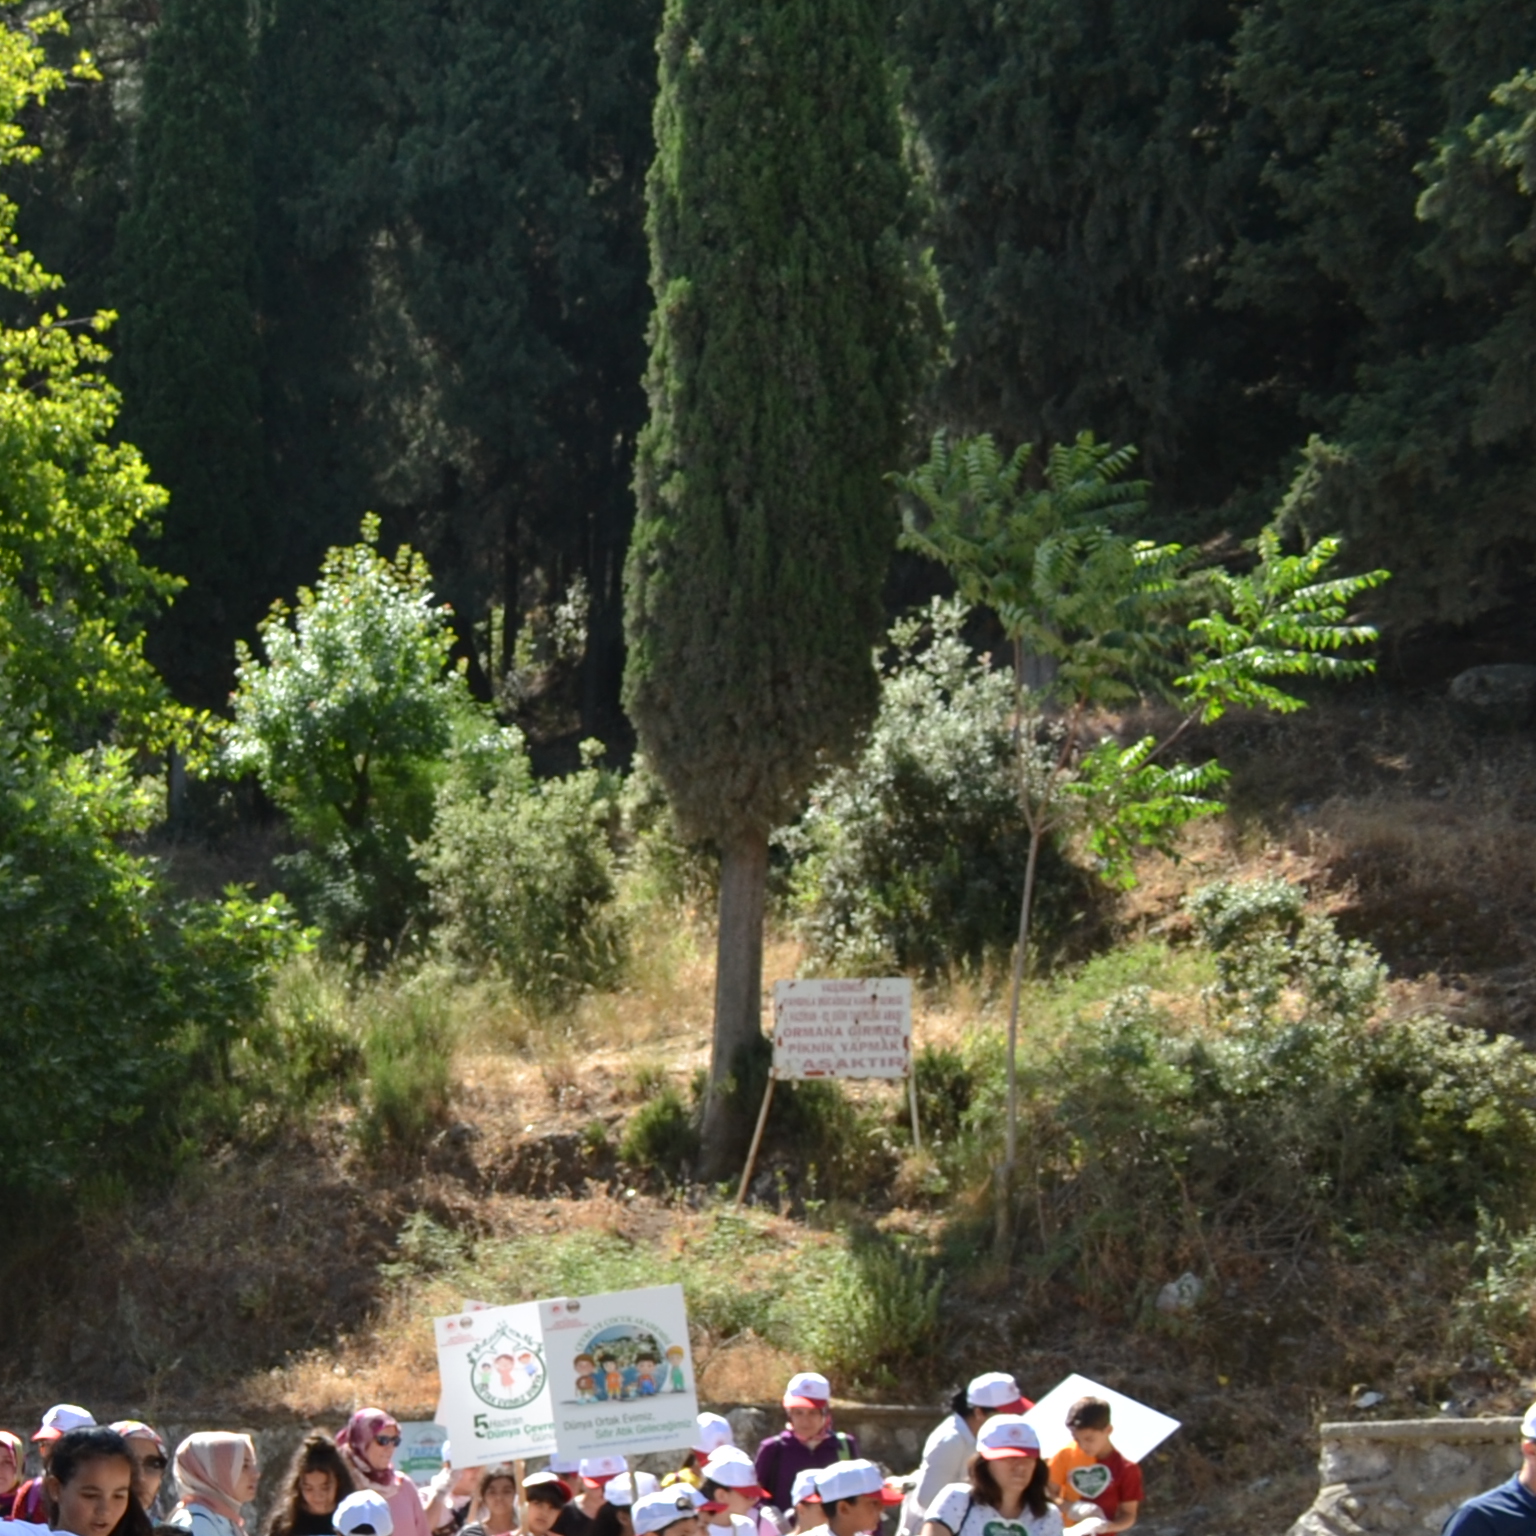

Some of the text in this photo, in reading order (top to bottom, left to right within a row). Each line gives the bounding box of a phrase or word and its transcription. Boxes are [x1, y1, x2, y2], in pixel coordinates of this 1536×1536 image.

[474, 1413, 490, 1439] 5
[487, 1427, 520, 1441] Dünya
[564, 1421, 593, 1434] Dünya
[595, 1415, 621, 1428] Ortak
